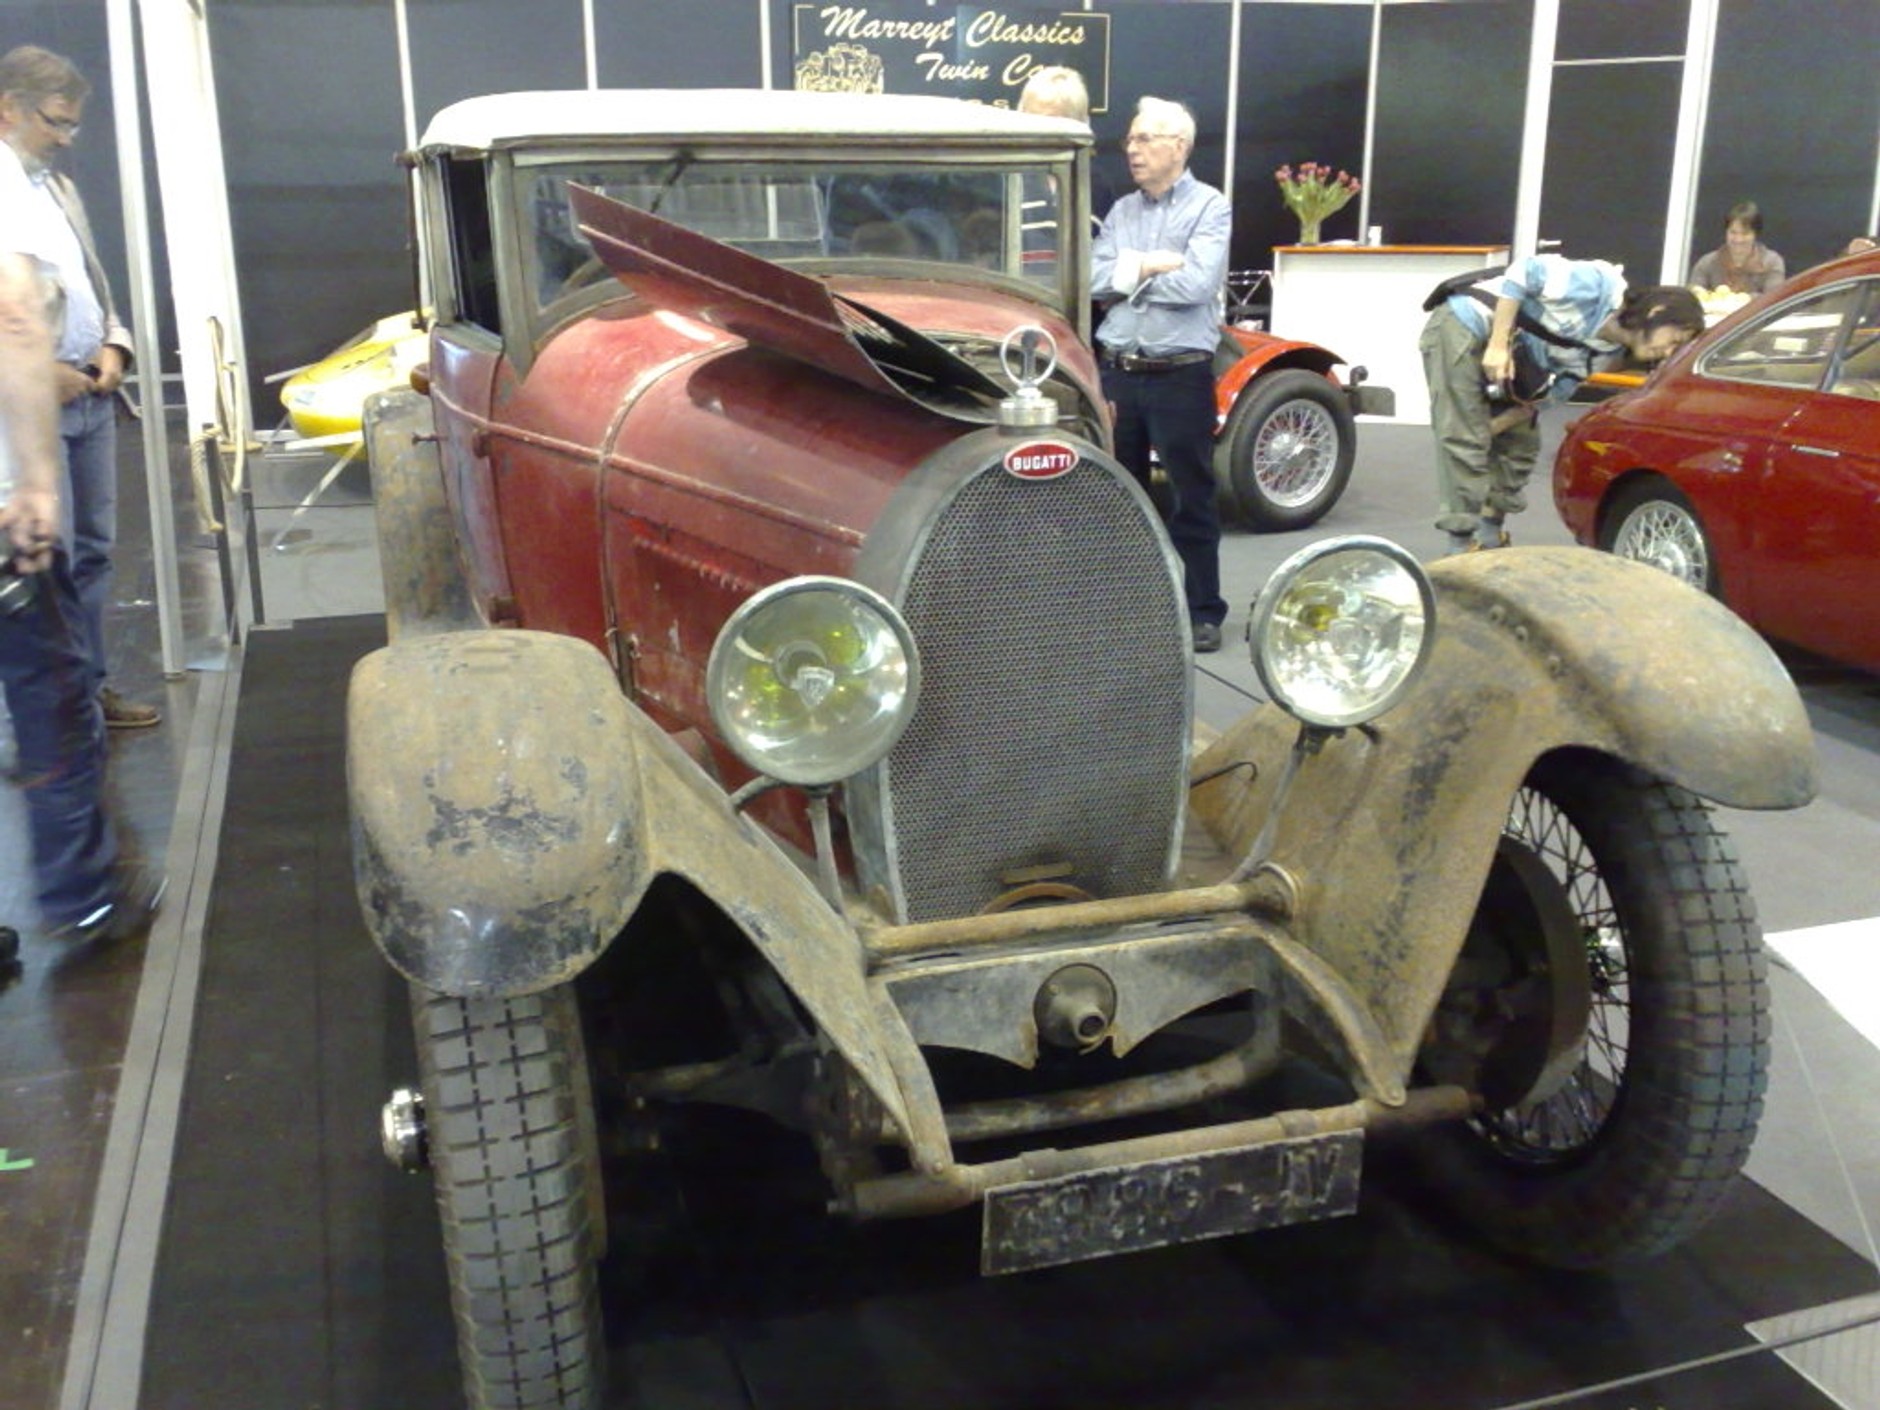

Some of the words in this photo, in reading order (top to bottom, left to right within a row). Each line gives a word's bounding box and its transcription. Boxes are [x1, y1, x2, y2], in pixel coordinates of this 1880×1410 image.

[820, 5, 956, 49] Marreyt
[965, 10, 1086, 48] Classics
[915, 52, 990, 83] Twin
[1012, 453, 1072, 472] BUGATTI
